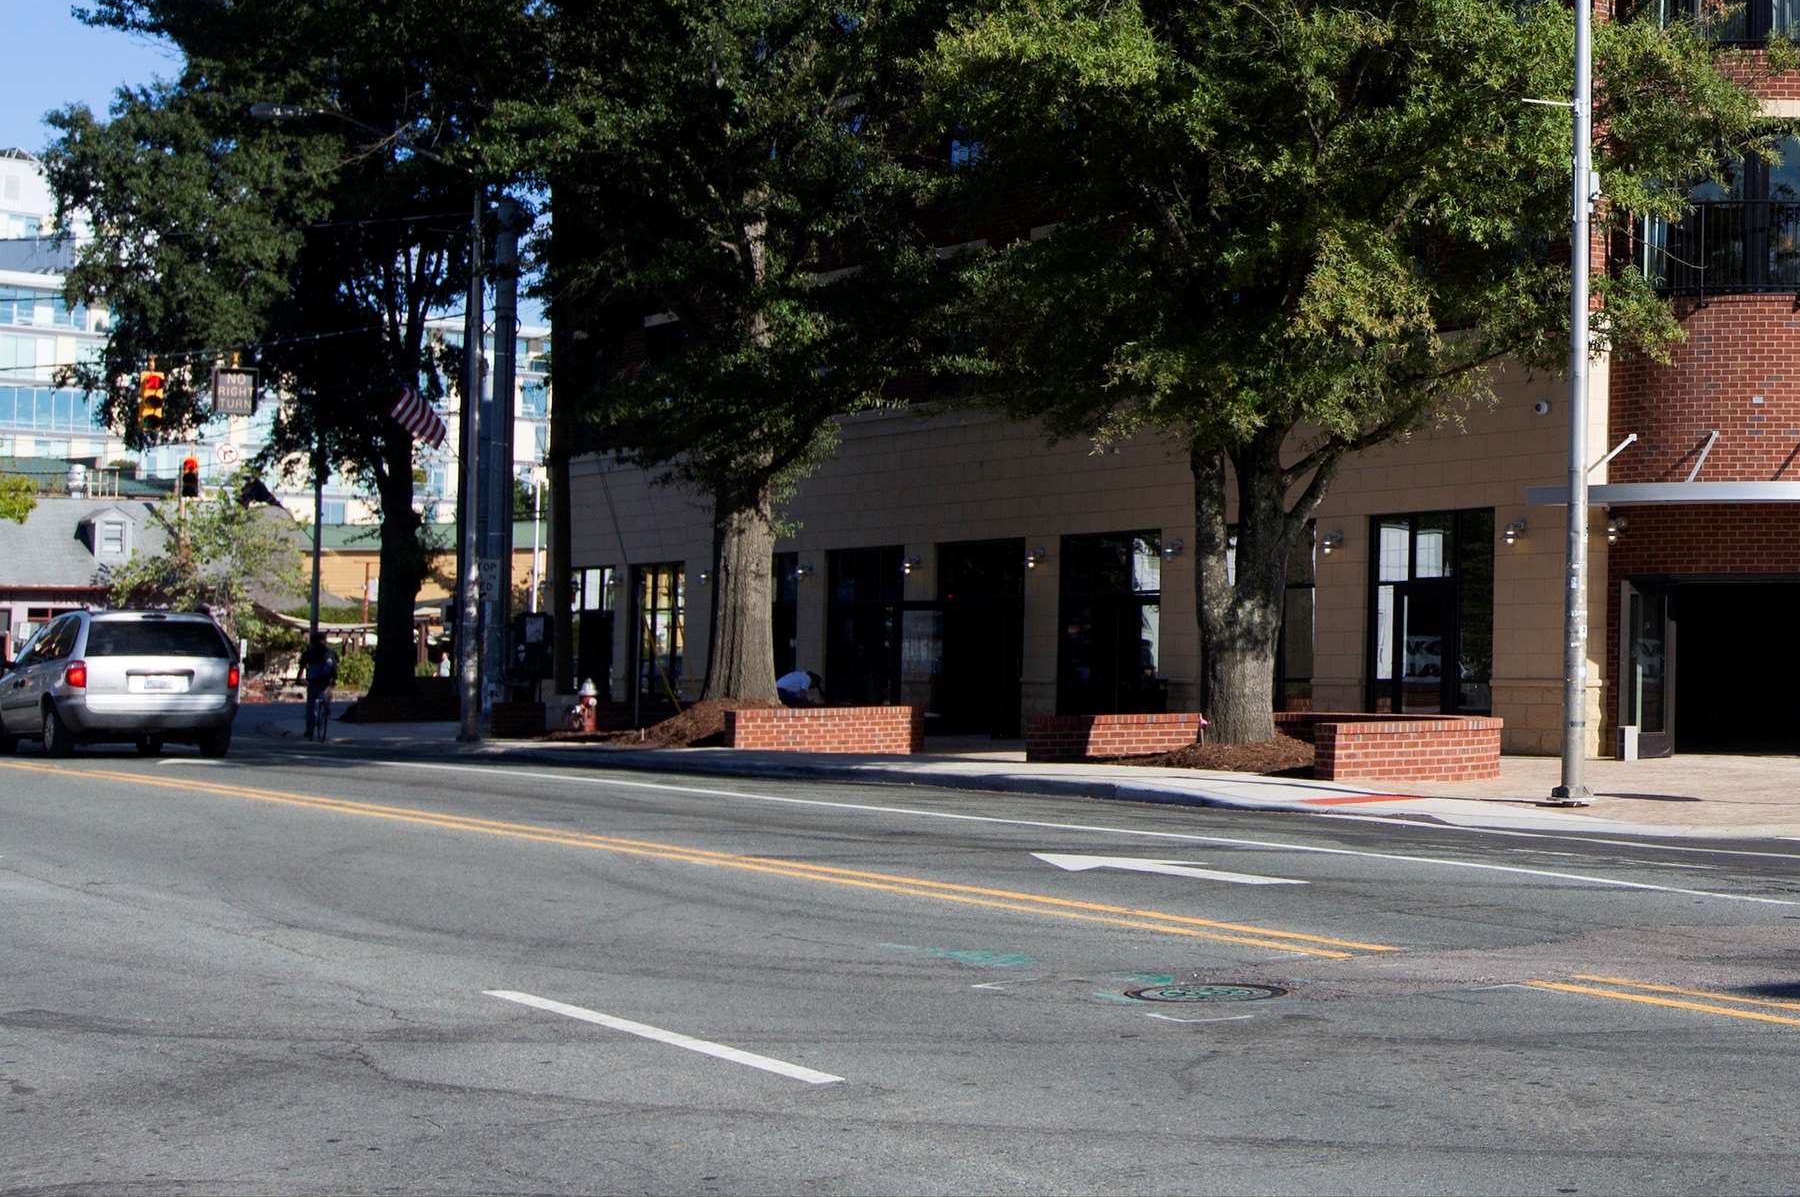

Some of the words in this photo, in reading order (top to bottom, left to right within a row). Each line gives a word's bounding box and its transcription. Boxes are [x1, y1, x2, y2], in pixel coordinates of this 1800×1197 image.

[227, 373, 246, 385] NO
[217, 386, 254, 397] RIGHT
[217, 398, 252, 409] TURN
